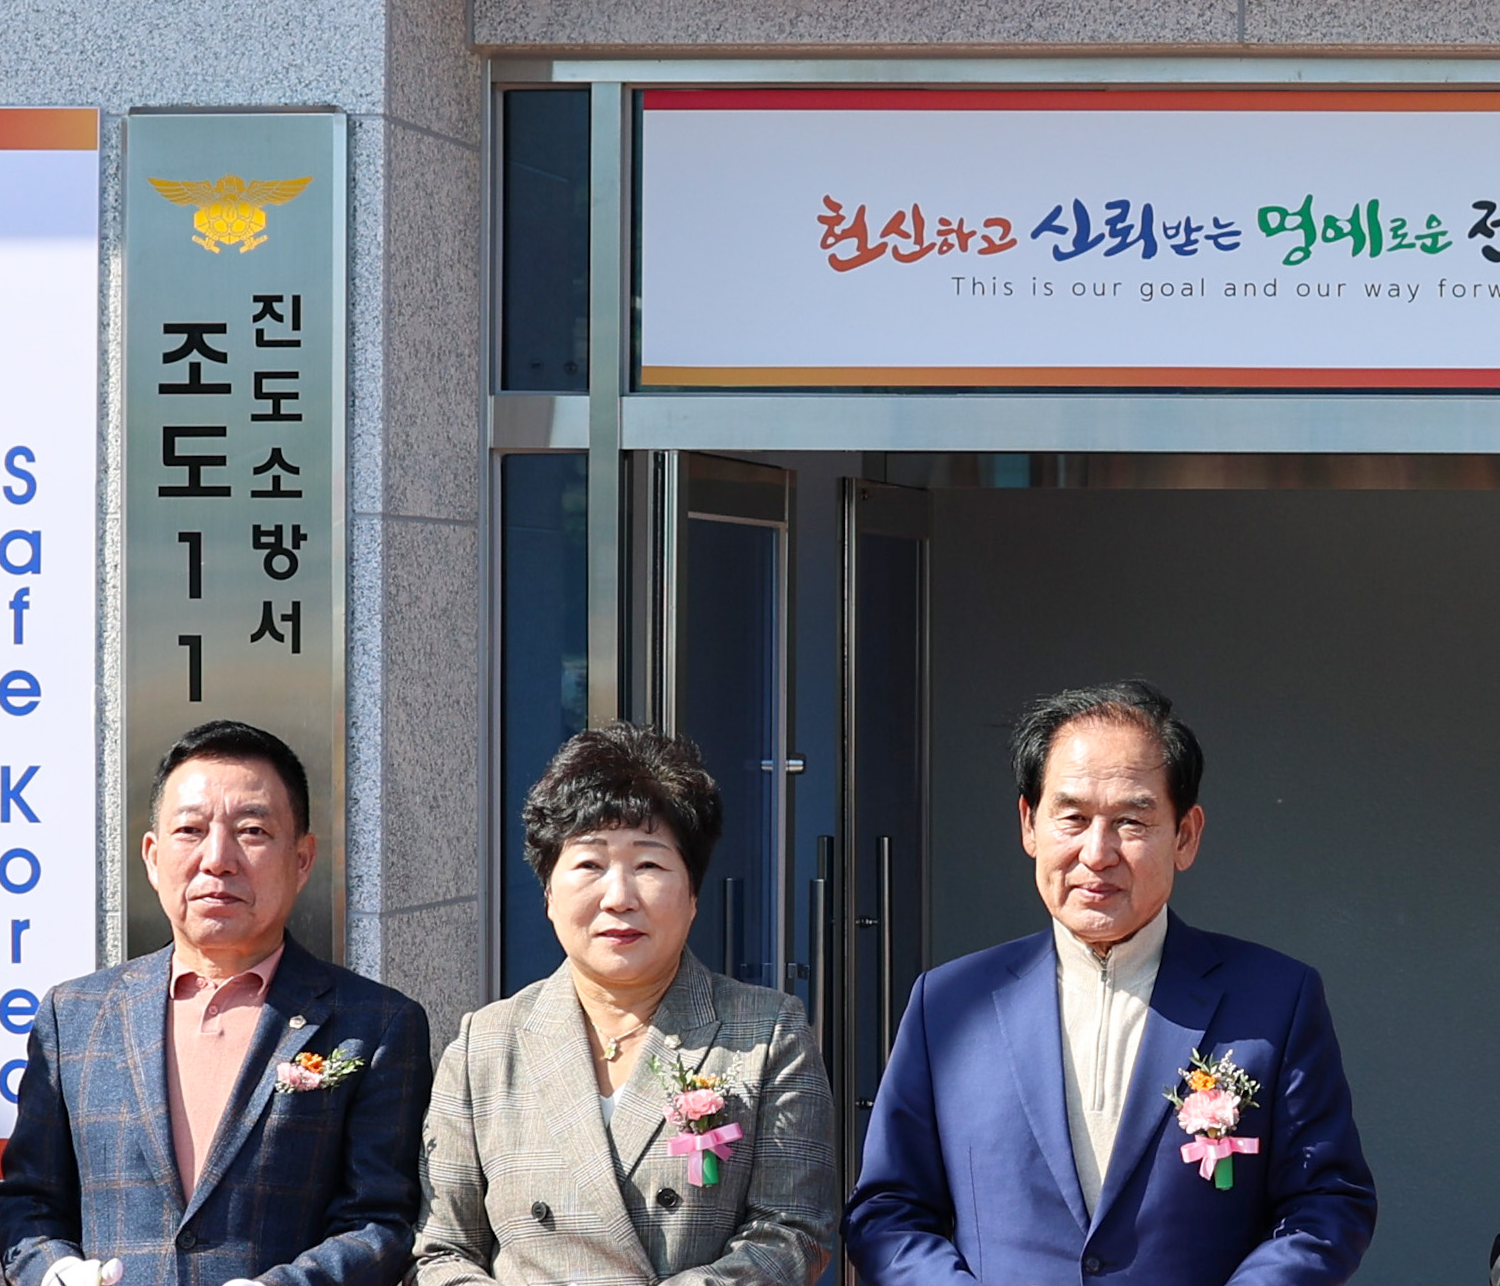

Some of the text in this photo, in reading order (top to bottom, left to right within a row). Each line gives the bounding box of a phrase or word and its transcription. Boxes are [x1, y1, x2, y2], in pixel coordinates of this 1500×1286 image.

[816, 194, 1018, 273] 헌신하고
[1030, 197, 1243, 262] 신뢰받는
[1257, 194, 1454, 266] 명예로운
[950, 275, 1014, 297] This
[1031, 276, 1054, 297] is
[1071, 281, 1123, 297] our
[1139, 276, 1206, 303] goal
[1223, 277, 1278, 298] and
[1295, 282, 1347, 298] our
[1363, 282, 1421, 304] way
[250, 294, 309, 654] 진도소방서
